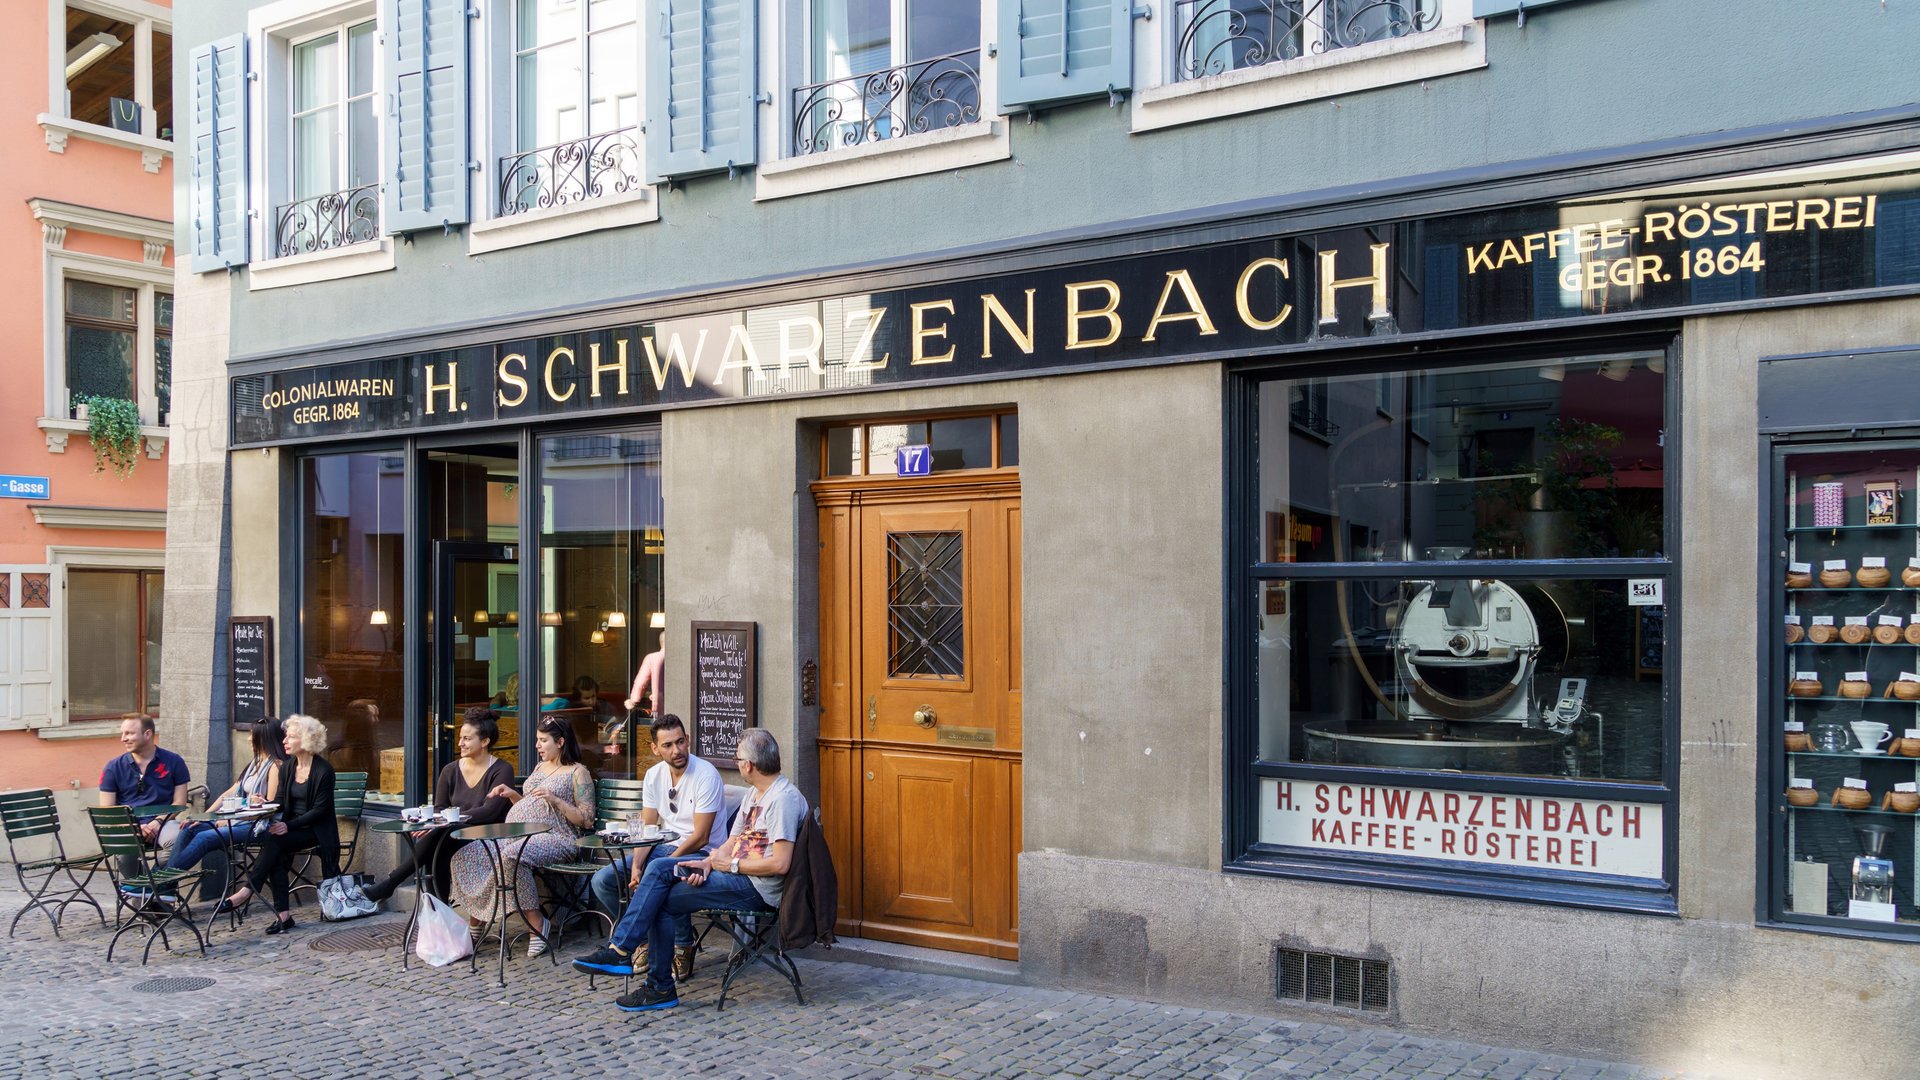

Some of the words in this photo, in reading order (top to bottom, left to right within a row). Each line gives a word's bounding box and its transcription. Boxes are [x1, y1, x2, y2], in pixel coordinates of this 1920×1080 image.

[1466, 195, 1877, 274] KAFFEE-RÖSTEREI
[1559, 255, 1671, 292] GEGR.
[1680, 241, 1765, 280] 1864
[425, 362, 468, 414] H.
[497, 242, 1390, 407] SCHWARZENBACH
[262, 379, 393, 411] COLONIALWAREN
[293, 405, 331, 425] GEGR.
[332, 402, 360, 420] 1864
[904, 450, 922, 472] 17
[1277, 781, 1300, 811] H.
[1315, 783, 1641, 839] SCHWARZENBACH
